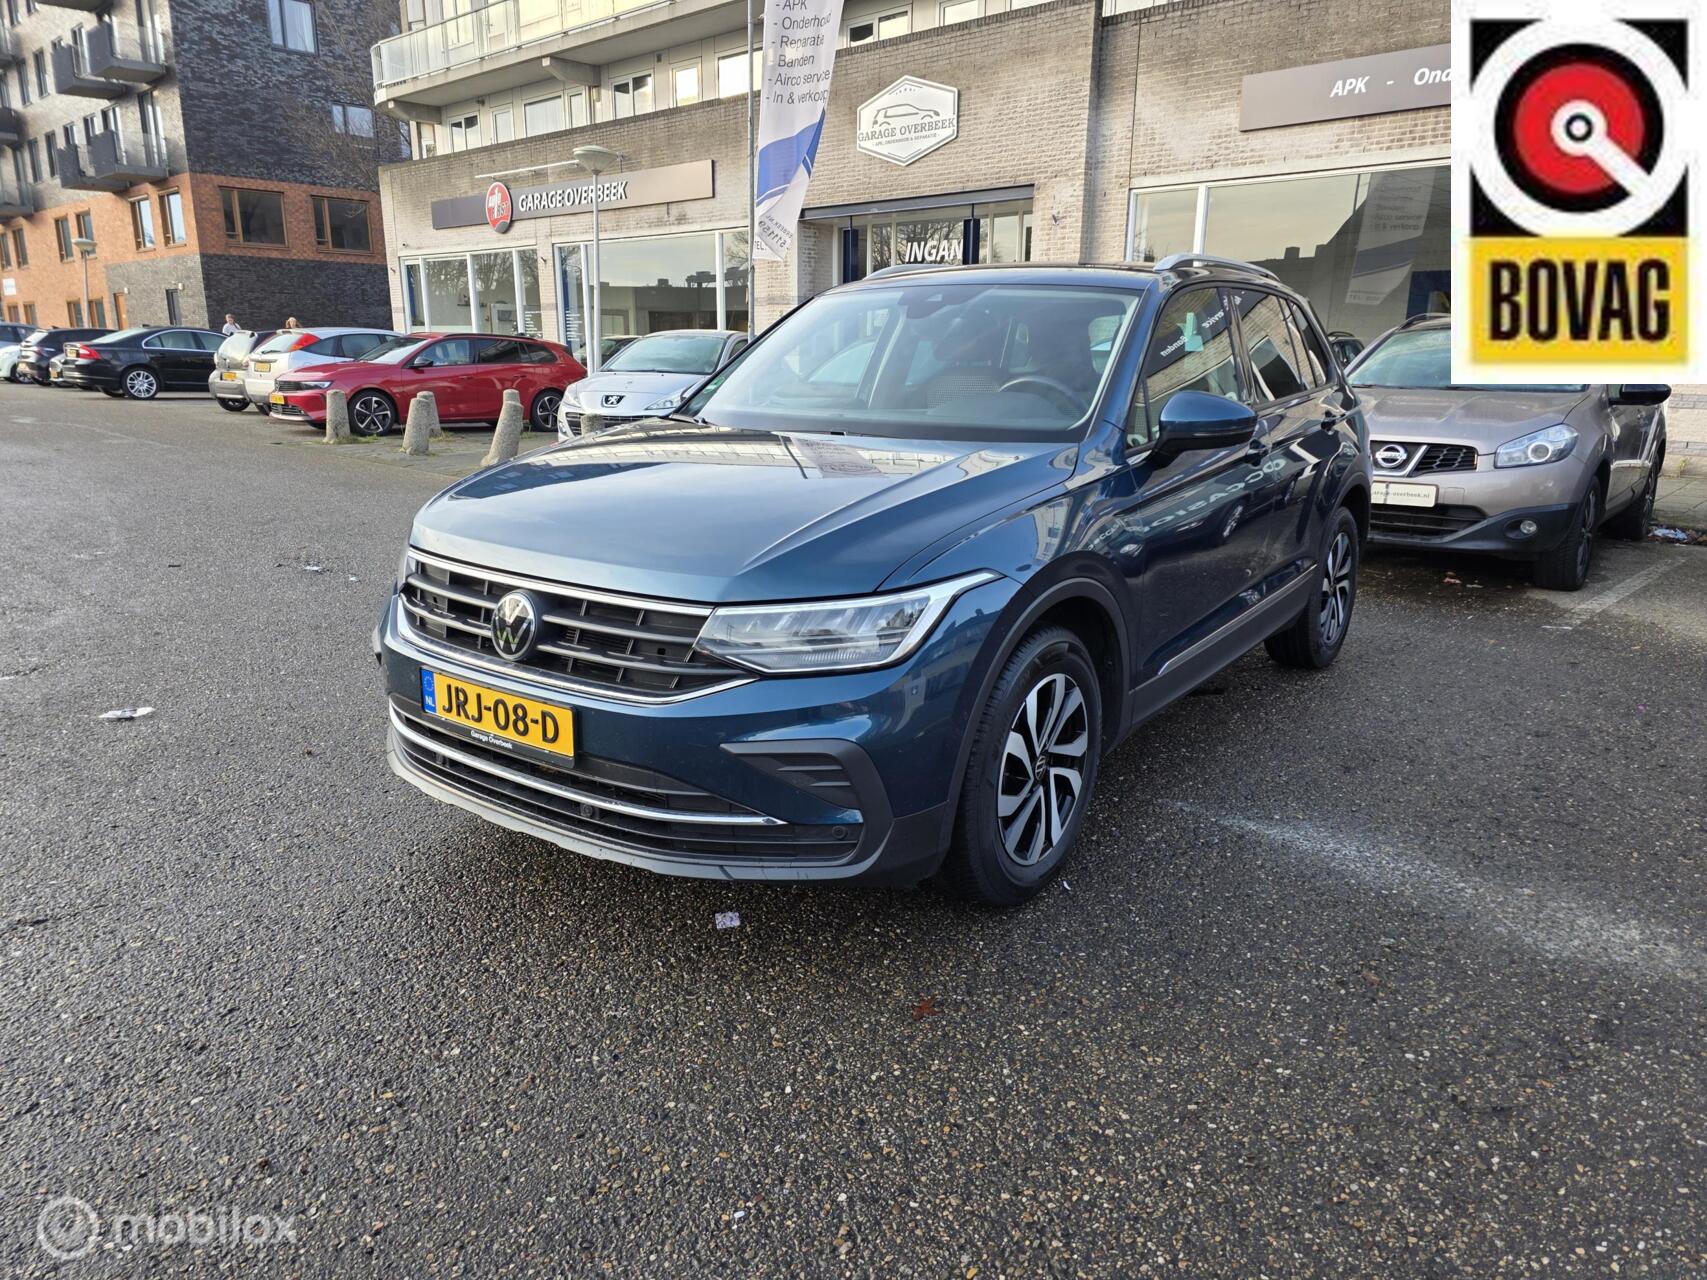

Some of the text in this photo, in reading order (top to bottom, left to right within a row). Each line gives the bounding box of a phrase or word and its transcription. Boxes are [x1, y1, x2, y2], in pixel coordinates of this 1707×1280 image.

[778, 54, 815, 67] Banden
[774, 73, 801, 86] Airco
[1329, 76, 1370, 98] APK
[772, 91, 784, 103] In
[787, 92, 795, 104] &
[858, 117, 956, 142] GARAGE OVERBEEK
[518, 190, 564, 212] GARAGE
[564, 181, 627, 207] OVERBEEK
[905, 239, 964, 263] INGAN
[425, 683, 559, 744] NL JRJ-08-D
[470, 730, 513, 749] Garage Overbeek
